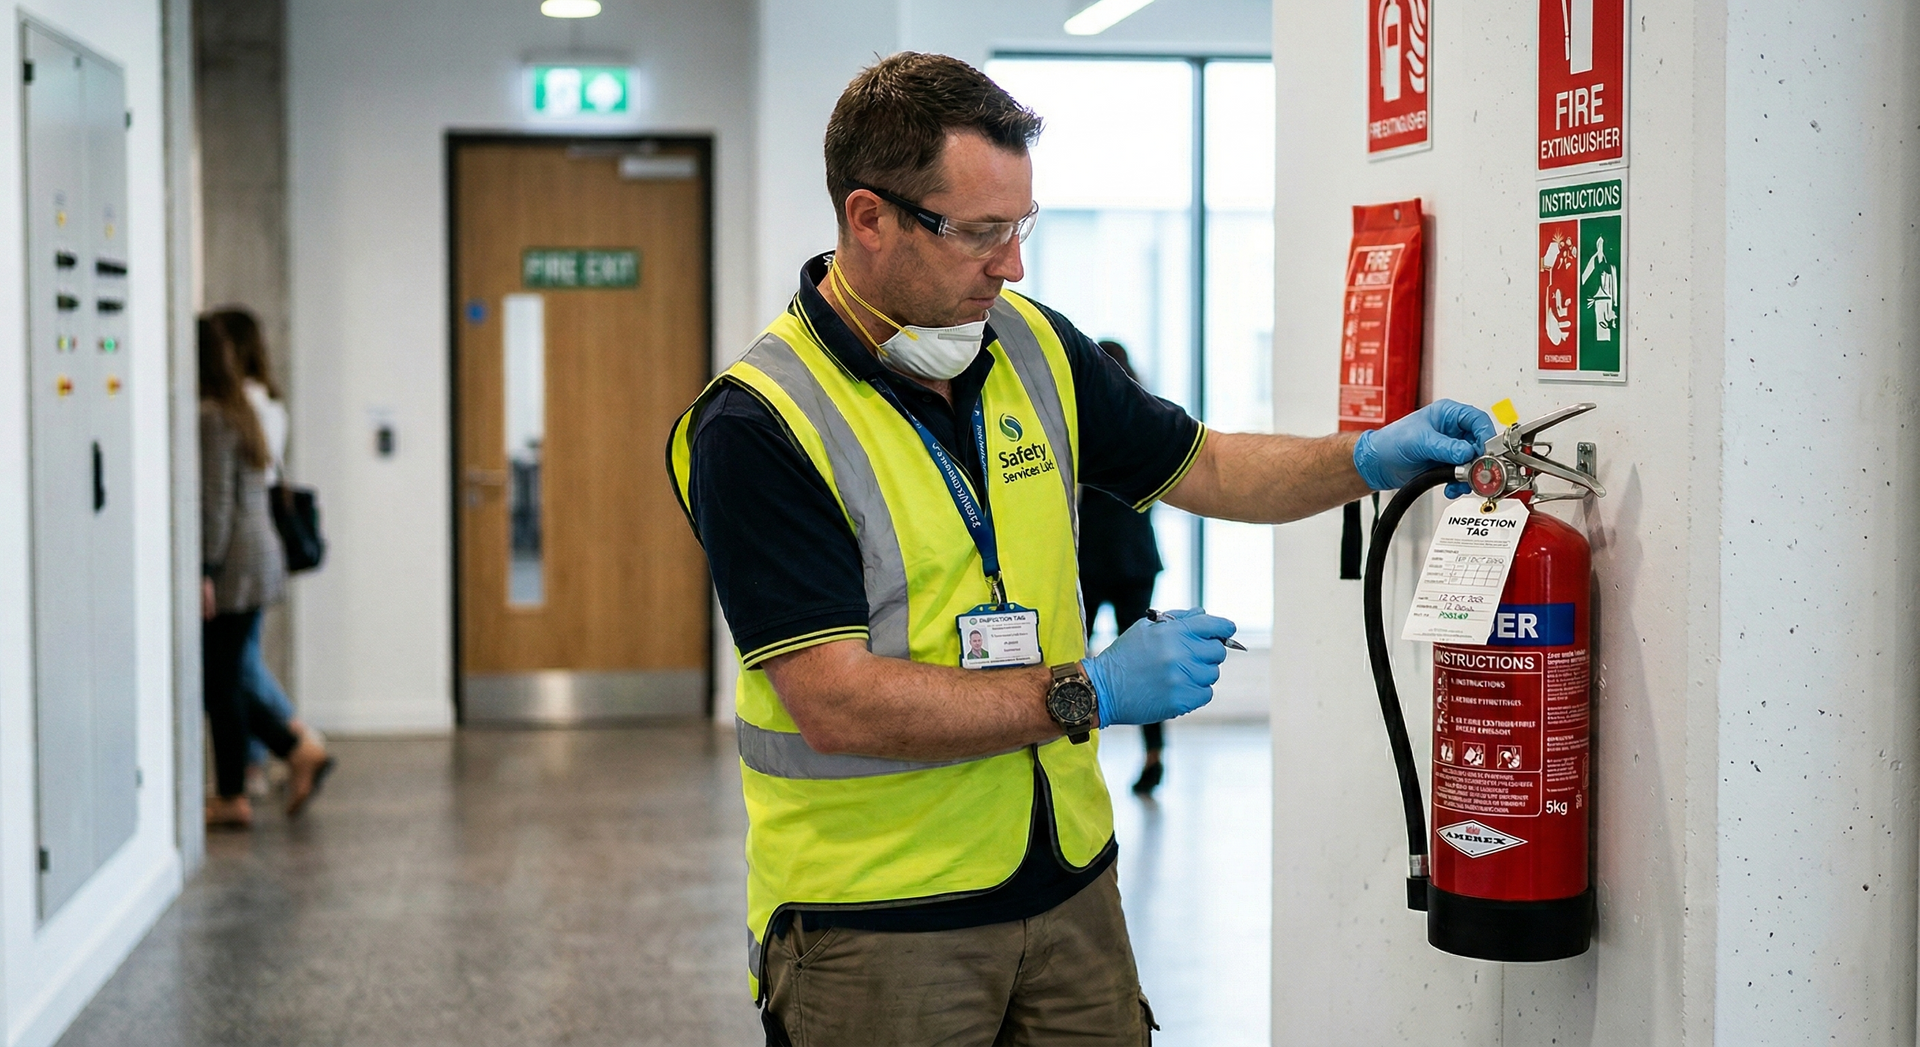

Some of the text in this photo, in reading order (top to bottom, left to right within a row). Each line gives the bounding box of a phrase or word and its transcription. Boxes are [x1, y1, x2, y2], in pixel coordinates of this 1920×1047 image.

[1555, 83, 1604, 131] FIRE
[1541, 127, 1620, 160] EXTINGUISHER
[1542, 185, 1620, 213] INSTRUCTIONS
[998, 443, 1046, 469] Safety
[1003, 466, 1041, 484] Services
[1448, 516, 1517, 528] INSPECTION
[1466, 527, 1489, 537] TAG
[1491, 612, 1539, 639] ER
[1545, 799, 1568, 816] 5kg
[1446, 831, 1506, 845] AMEREX
